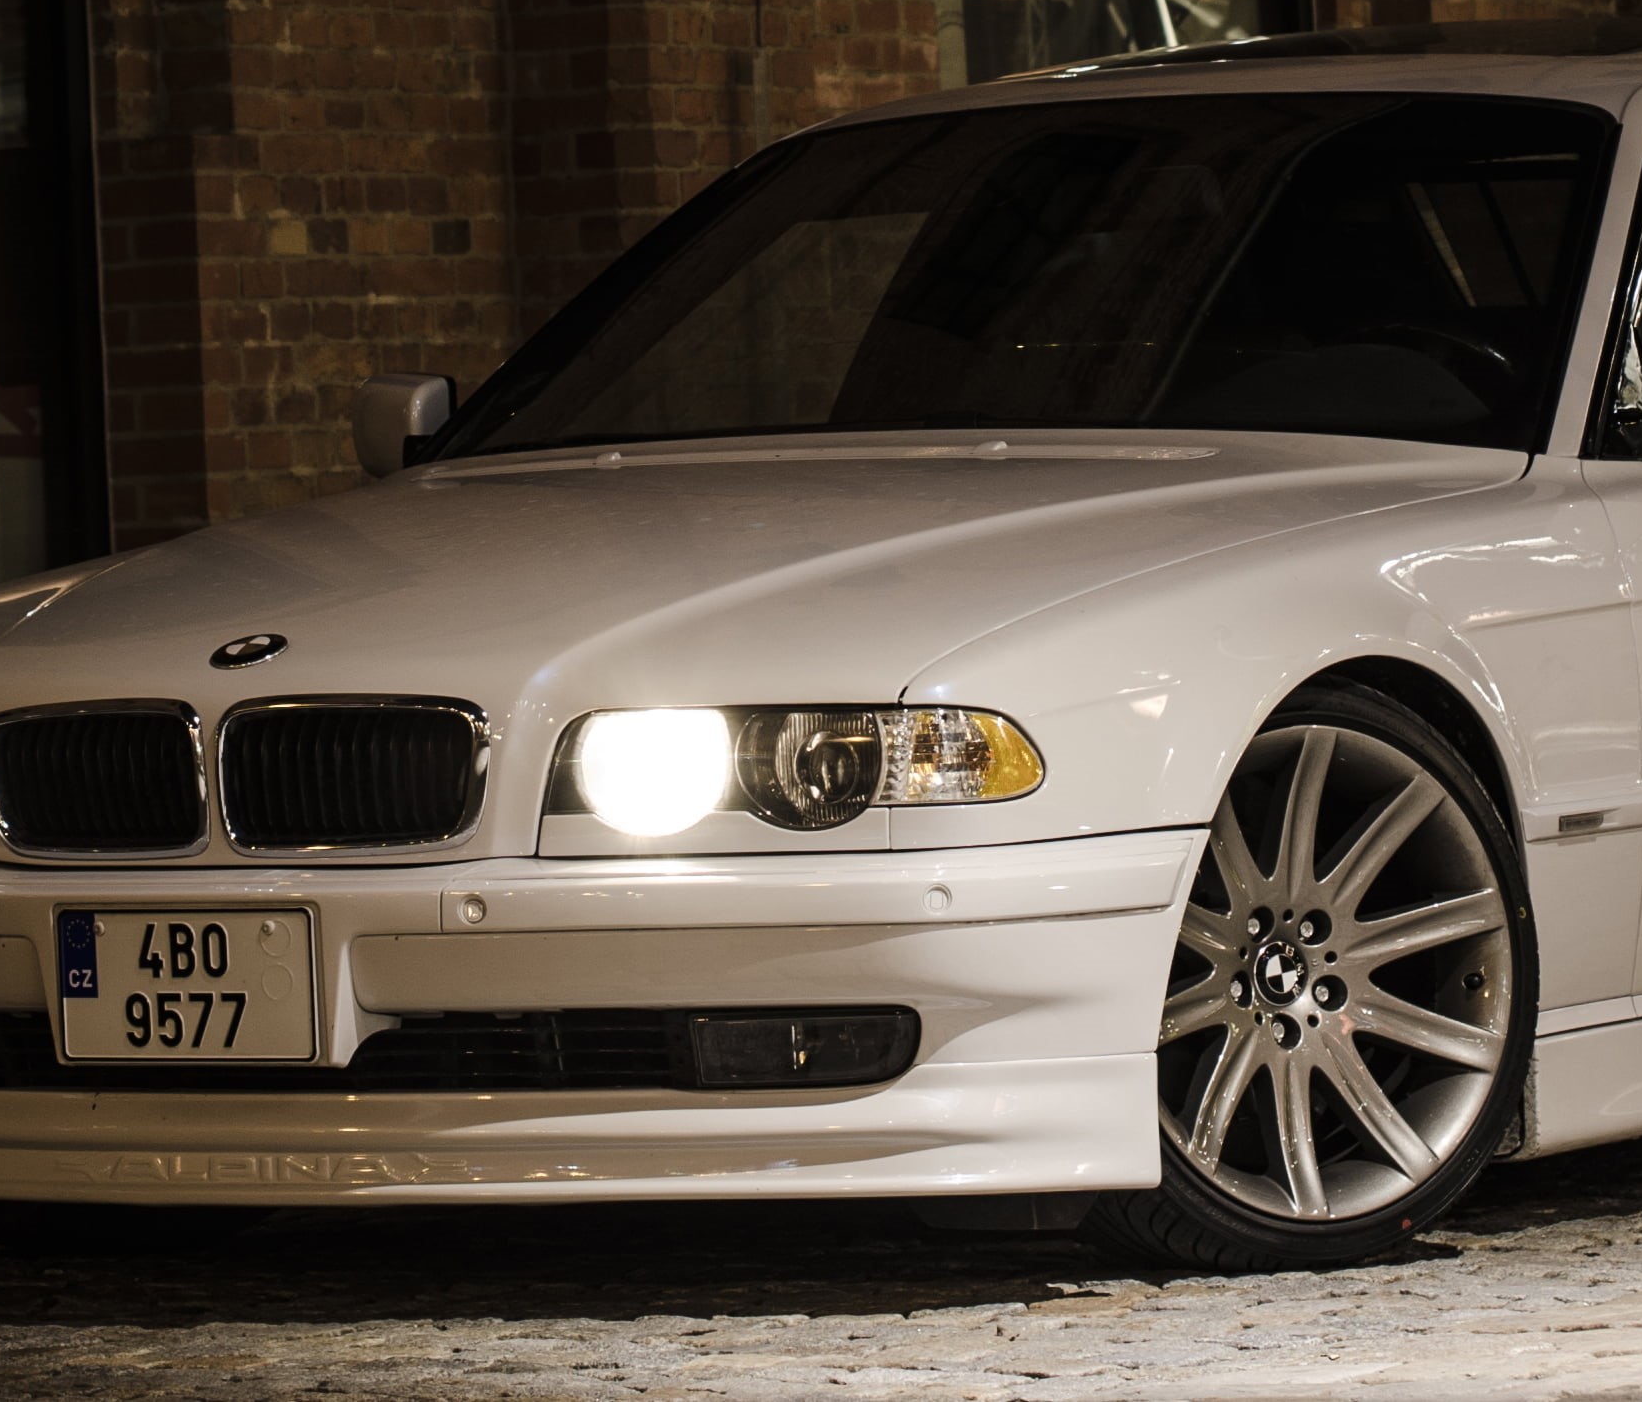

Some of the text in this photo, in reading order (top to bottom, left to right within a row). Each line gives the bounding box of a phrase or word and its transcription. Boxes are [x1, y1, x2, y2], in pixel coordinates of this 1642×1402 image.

[138, 922, 230, 978] 4B0
[68, 969, 93, 988] CZ
[125, 992, 248, 1048] 9577
